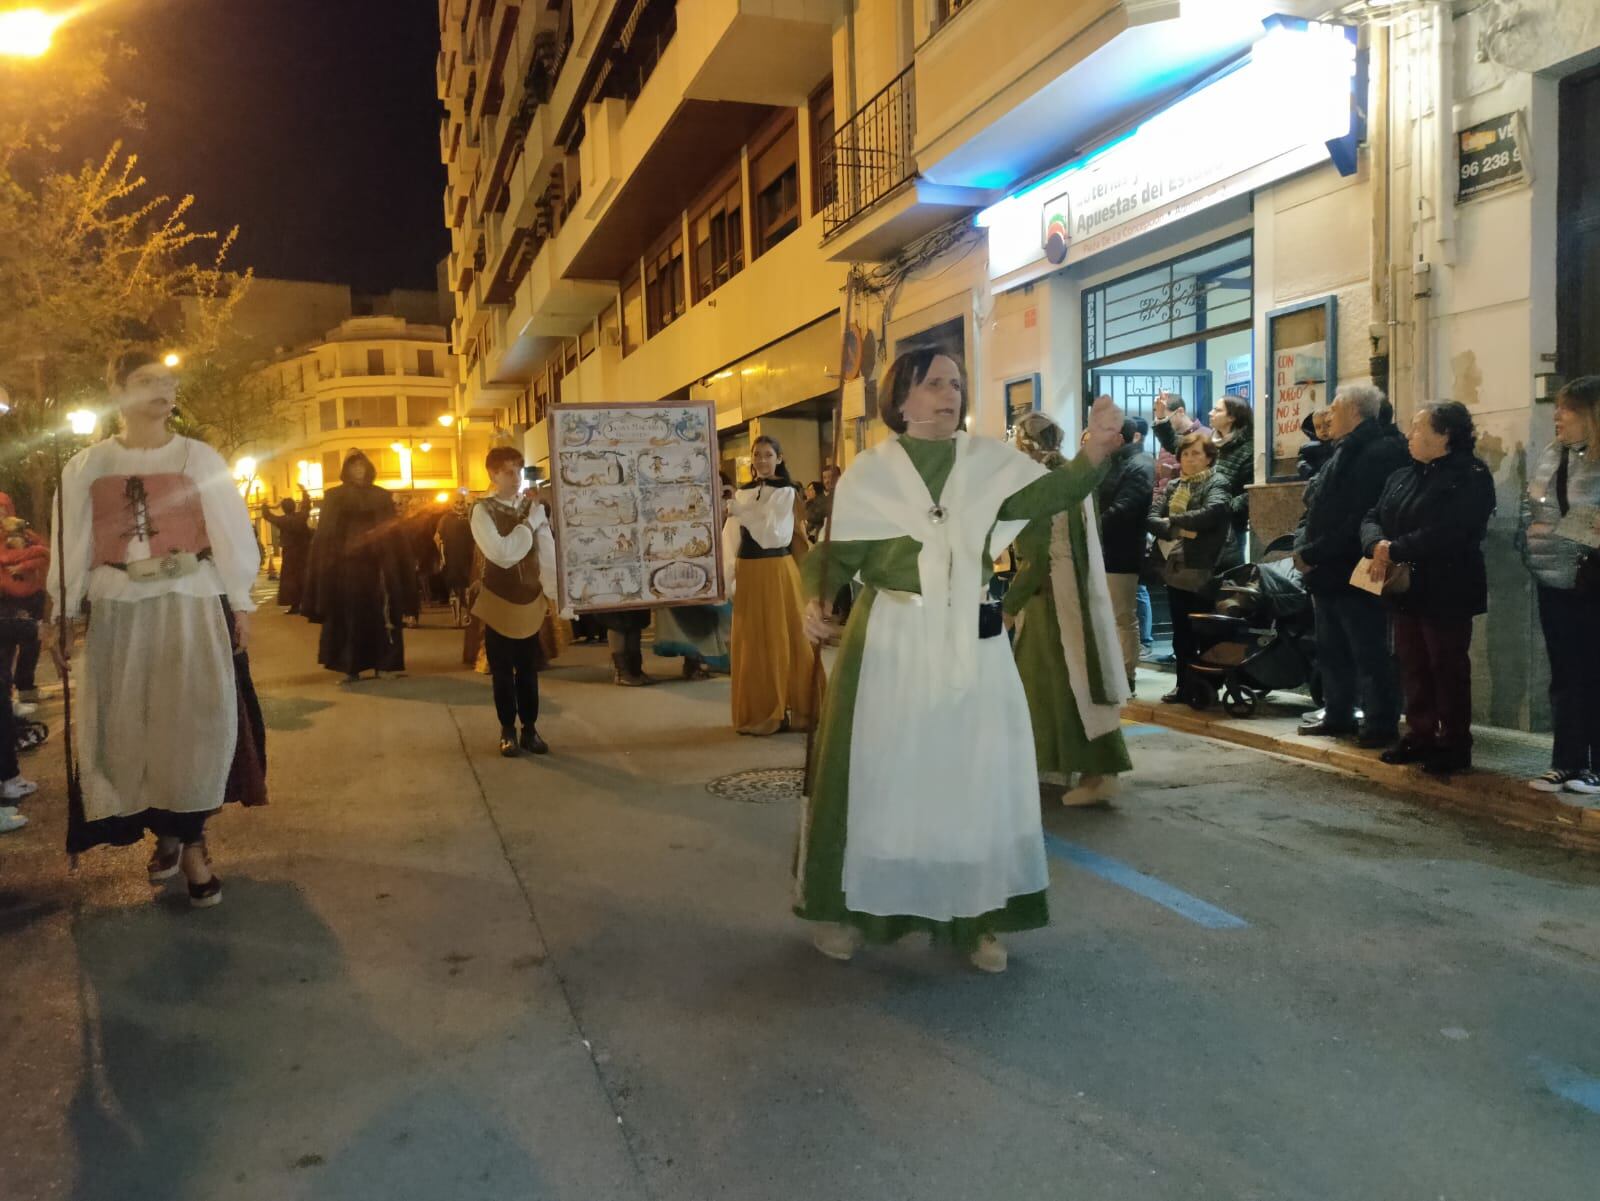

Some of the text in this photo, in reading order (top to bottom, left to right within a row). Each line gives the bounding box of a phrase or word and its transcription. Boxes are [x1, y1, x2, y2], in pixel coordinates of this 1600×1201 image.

[1461, 161, 1479, 179] 96
[1482, 151, 1509, 172] 238
[1077, 194, 1137, 234] Apuestas
[1142, 182, 1163, 201] del
[1277, 355, 1294, 369] CON
[1276, 407, 1289, 419] NO
